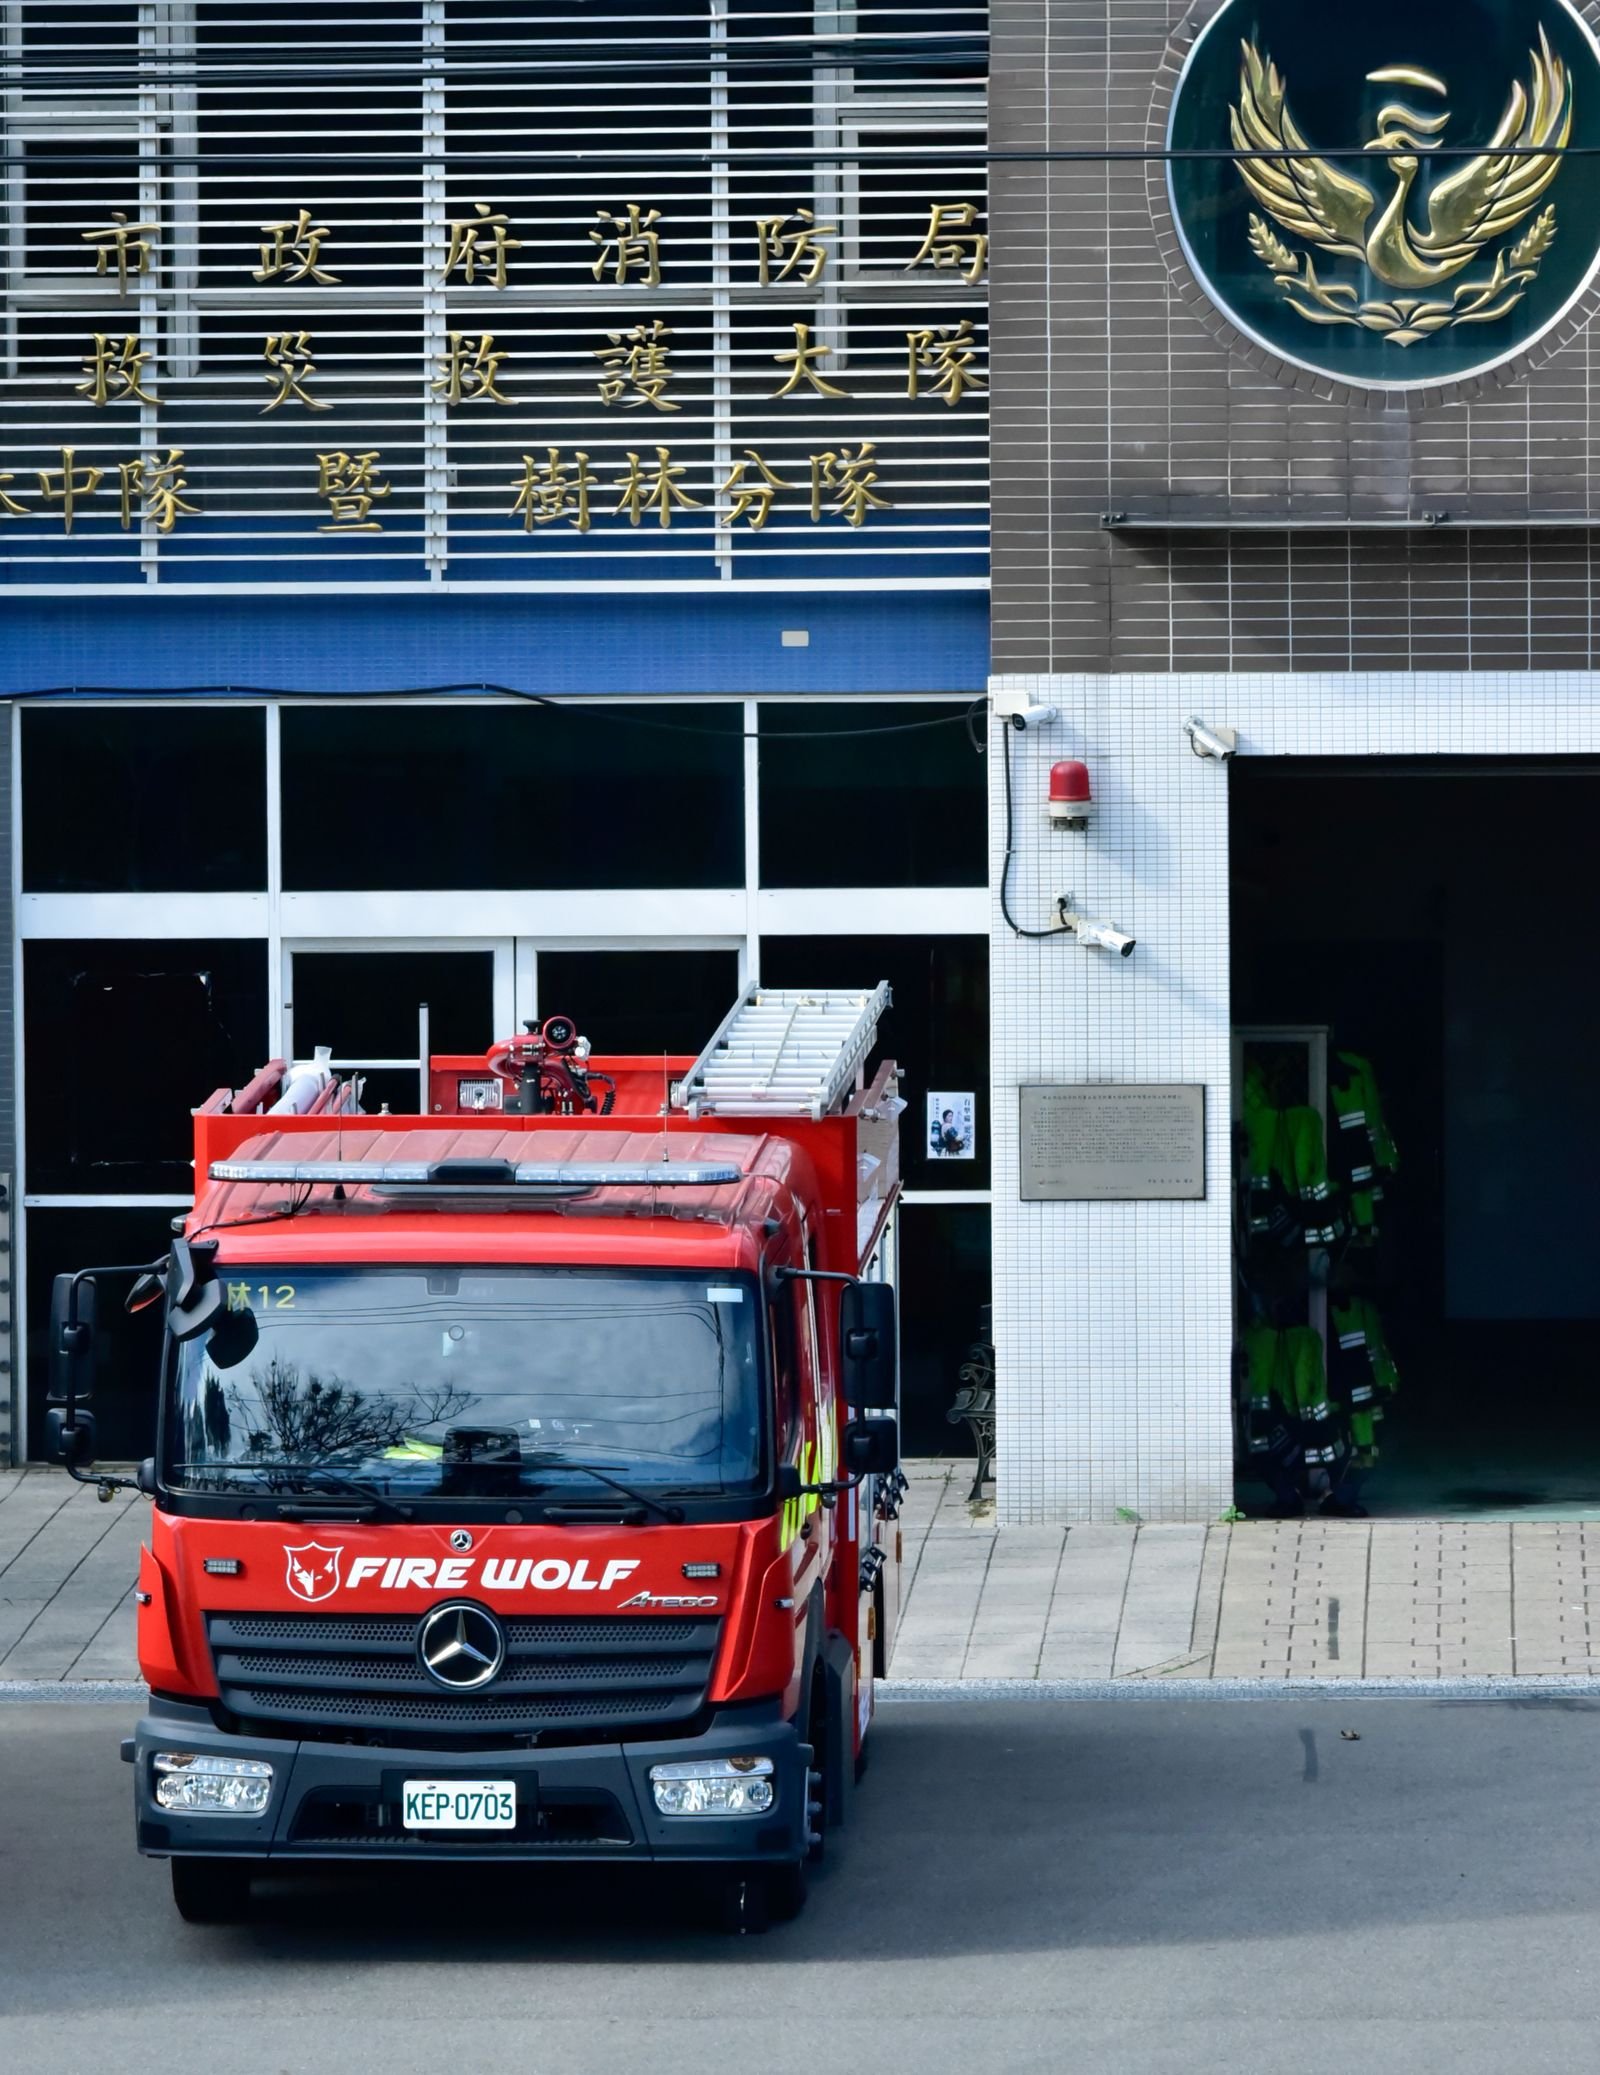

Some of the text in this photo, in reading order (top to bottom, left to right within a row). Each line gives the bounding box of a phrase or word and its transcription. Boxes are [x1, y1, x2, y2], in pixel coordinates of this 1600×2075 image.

[81, 203, 988, 299] 市政府消防局
[75, 319, 988, 415] 救災救護大隊
[316, 451, 391, 533] 暨
[508, 442, 894, 533] 樹林分隊
[345, 1557, 641, 1590] FIRE WOLF
